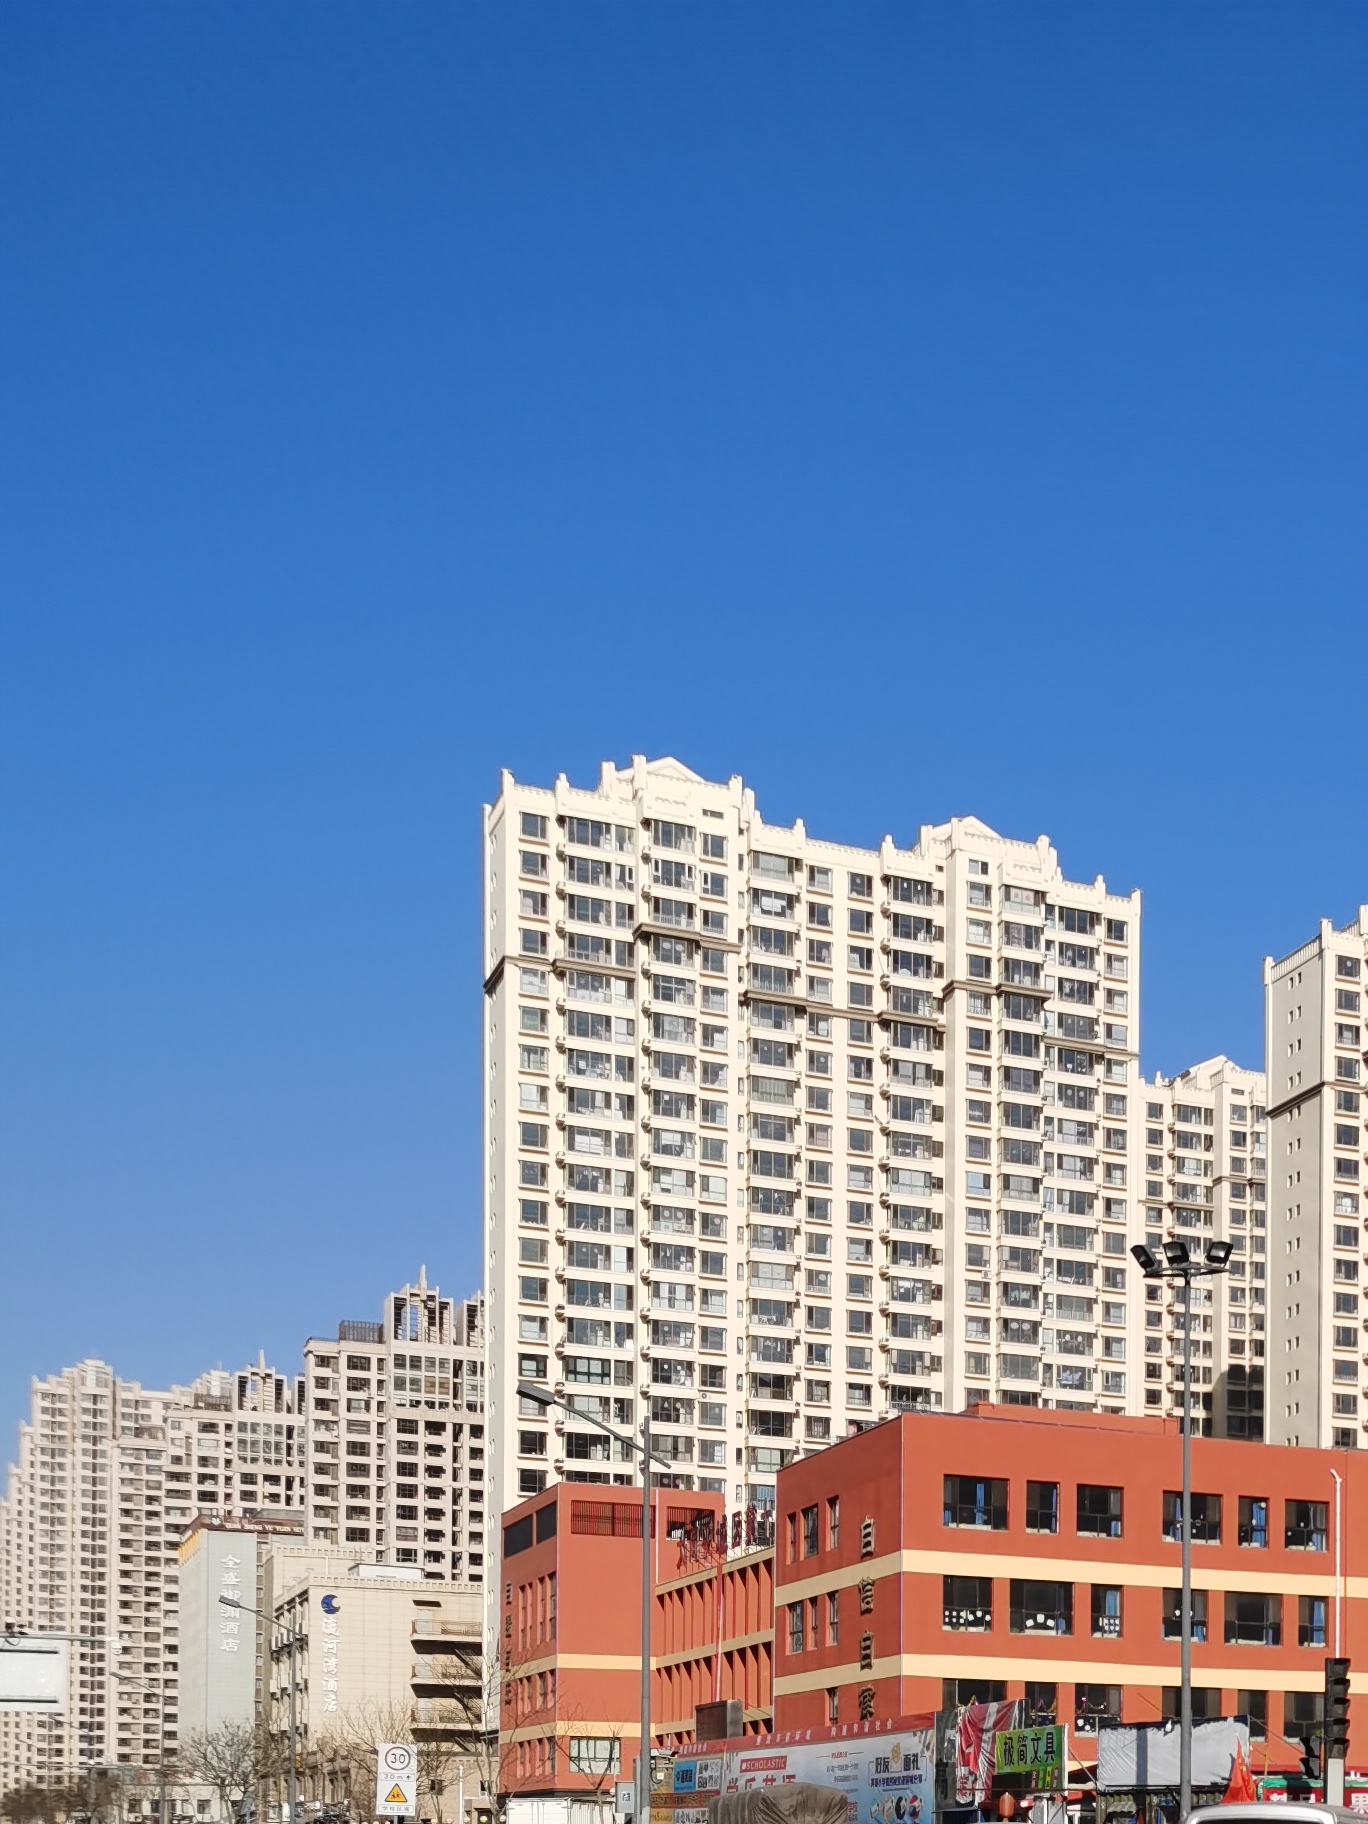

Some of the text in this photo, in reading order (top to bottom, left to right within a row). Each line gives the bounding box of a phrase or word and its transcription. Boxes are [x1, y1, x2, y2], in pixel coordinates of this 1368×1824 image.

[1003, 1731, 1056, 1767] 极简文具
[390, 1753, 406, 1764] 30
[745, 1756, 787, 1770] SCHOLASTIC
